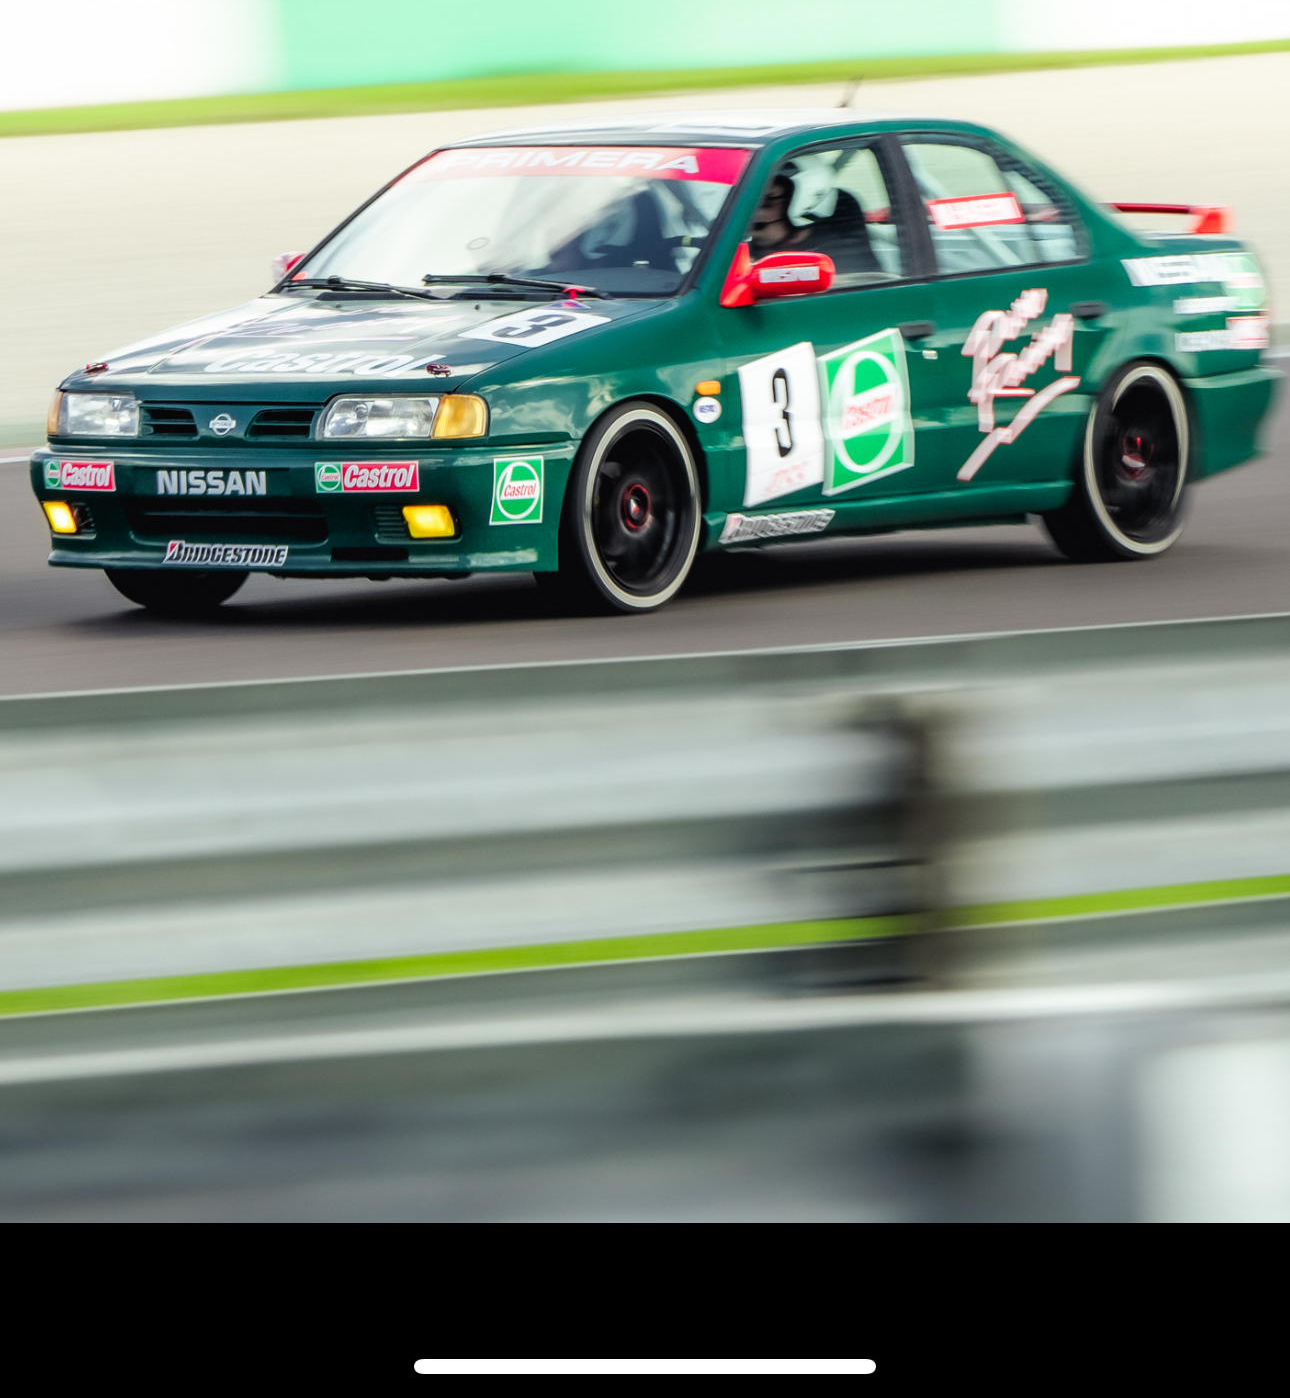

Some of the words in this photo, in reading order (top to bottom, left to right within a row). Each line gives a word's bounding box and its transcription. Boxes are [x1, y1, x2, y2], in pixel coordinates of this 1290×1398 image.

[439, 151, 699, 174] PRIMERA
[491, 314, 577, 338] 3
[204, 349, 447, 378] Castrol
[771, 368, 794, 458] 3
[62, 463, 111, 487] Castrol
[157, 470, 267, 495] NISSAN
[344, 465, 415, 488] Castrol
[503, 483, 537, 497] Castrol
[166, 541, 288, 565] BRIDGESTONE
